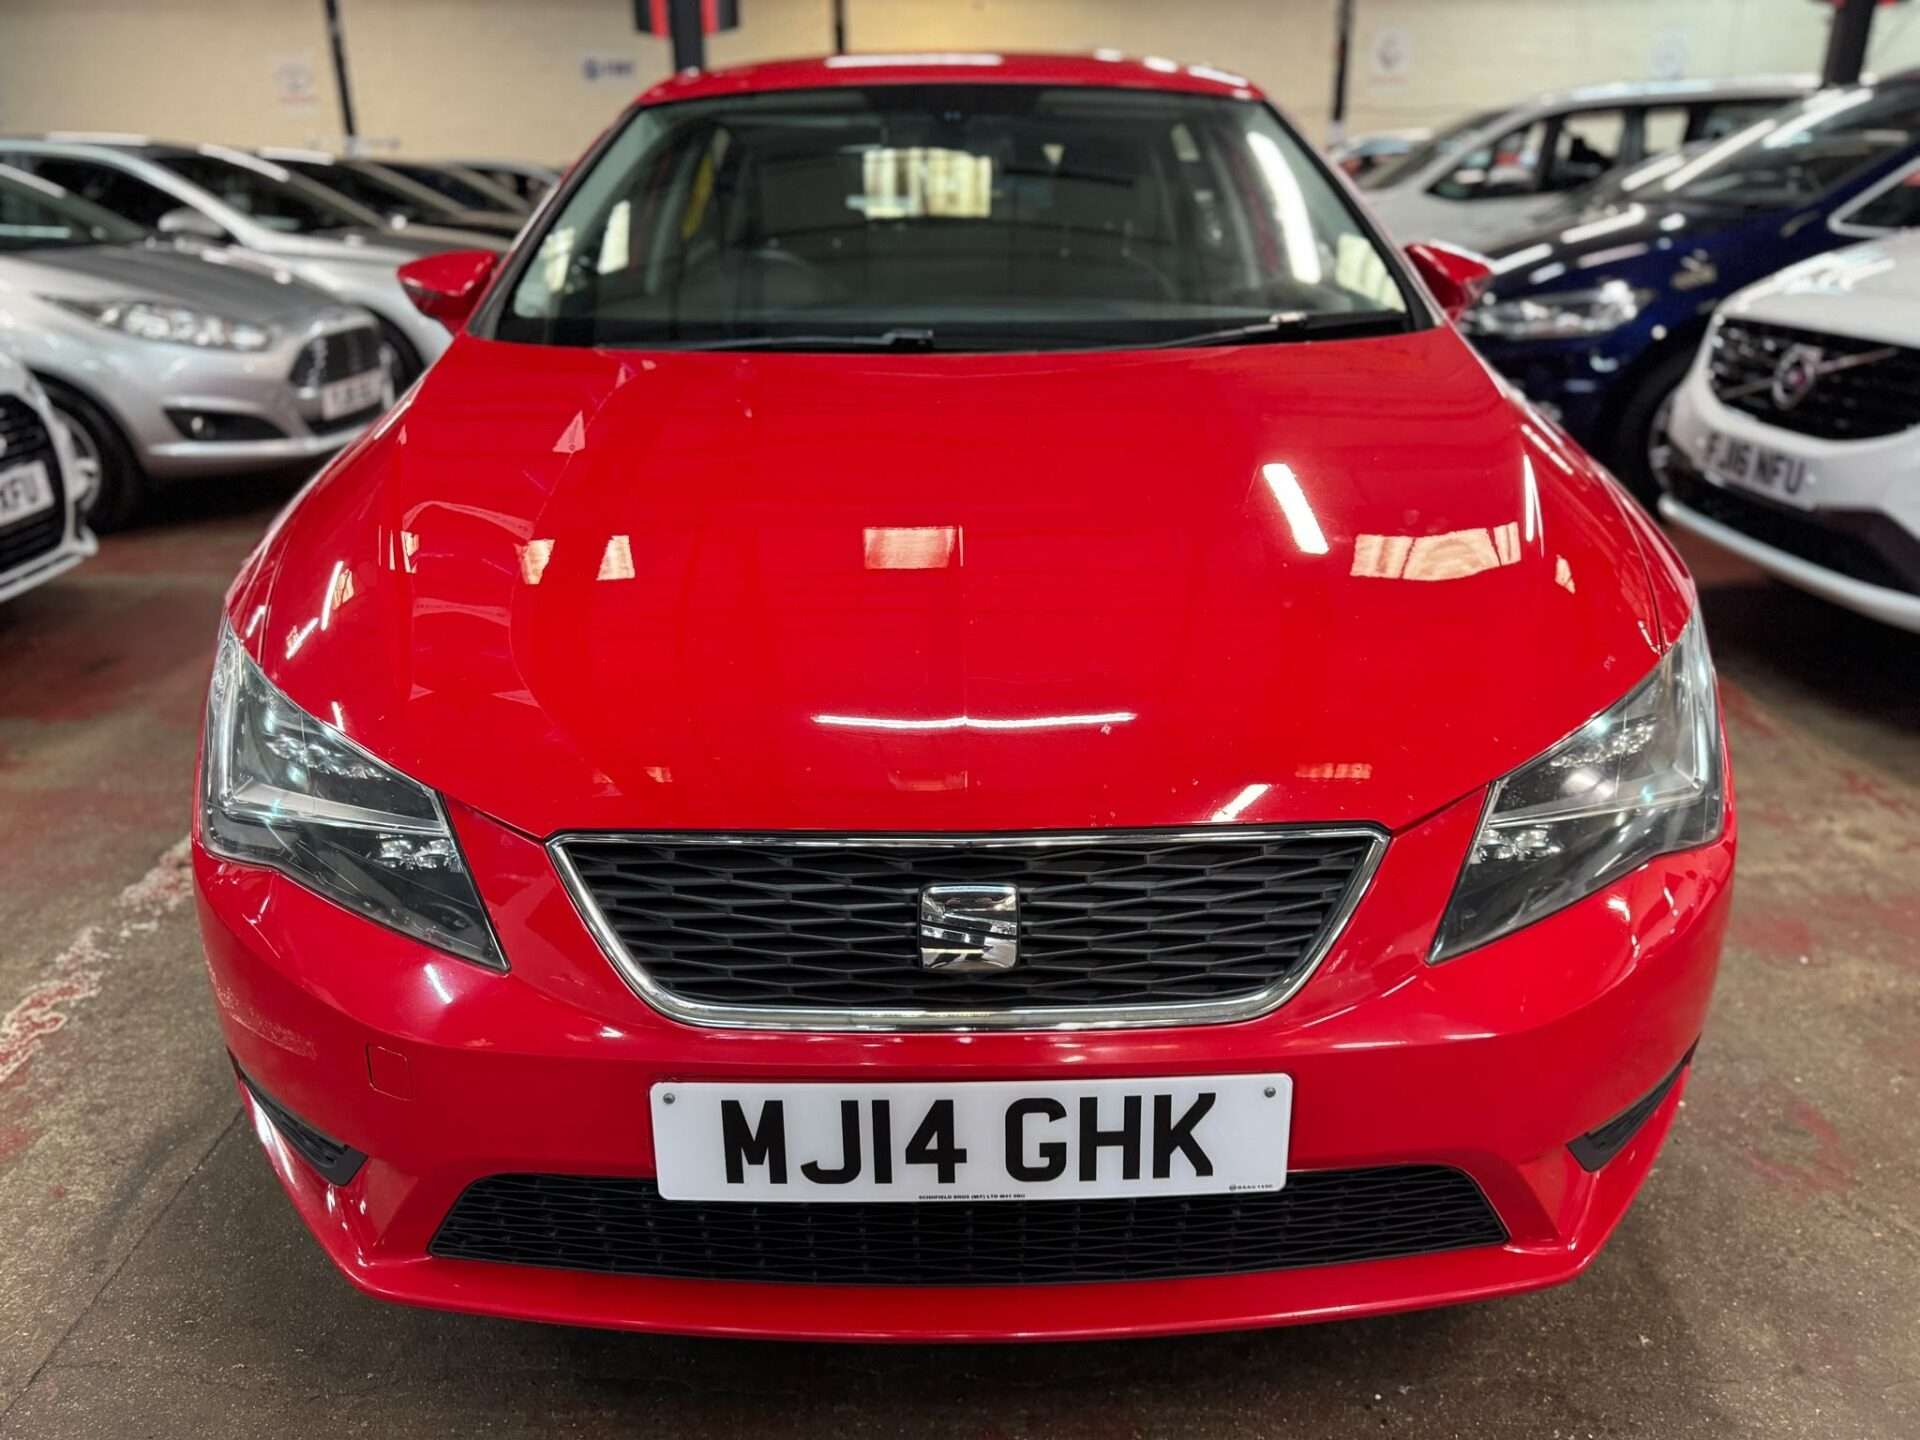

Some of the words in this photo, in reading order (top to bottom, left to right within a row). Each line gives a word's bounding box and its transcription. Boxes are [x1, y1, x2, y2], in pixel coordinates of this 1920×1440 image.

[1754, 448, 1806, 494] NFU
[721, 1099, 967, 1184] MJ14
[1005, 1092, 1217, 1182] GHK
